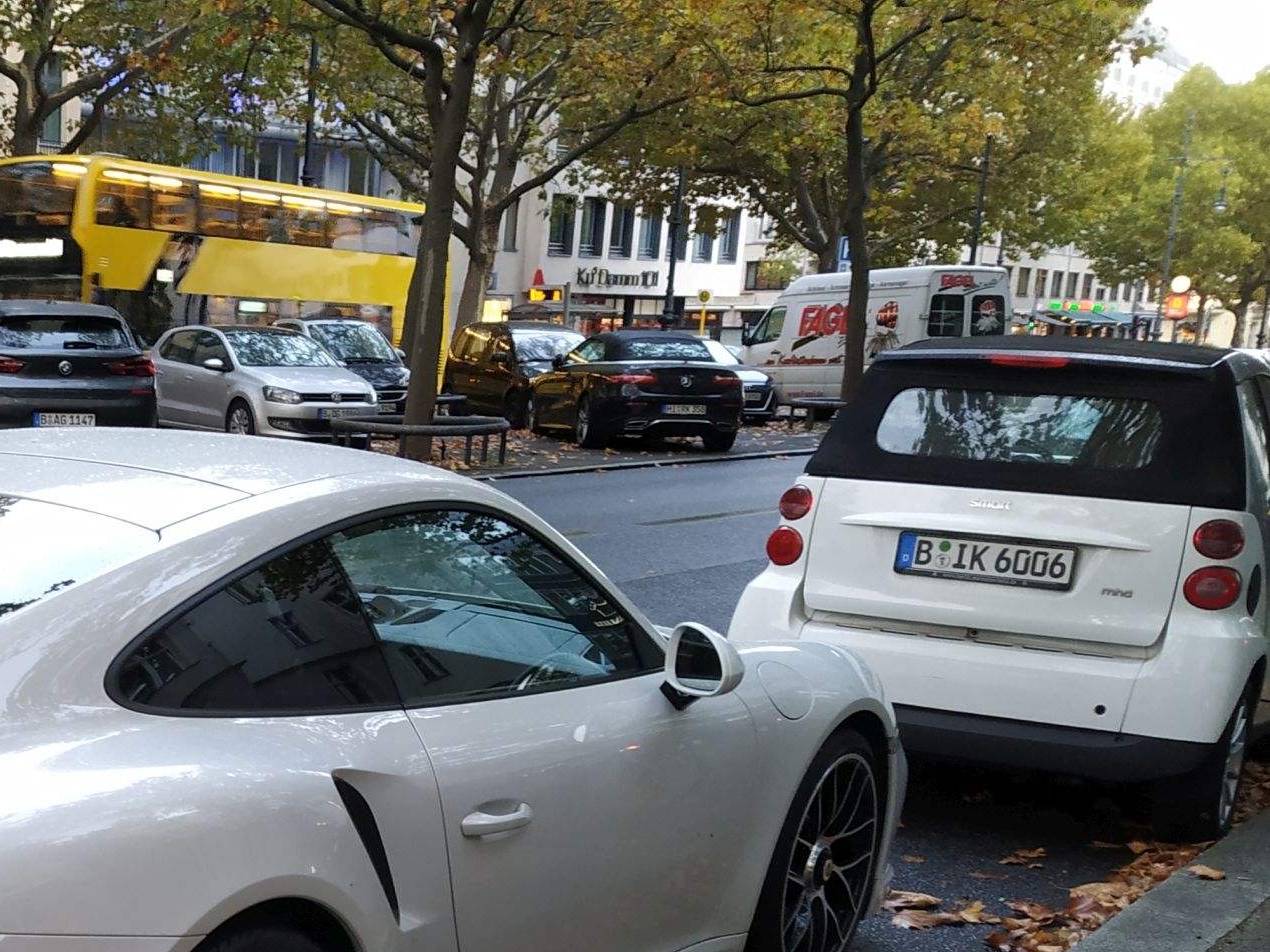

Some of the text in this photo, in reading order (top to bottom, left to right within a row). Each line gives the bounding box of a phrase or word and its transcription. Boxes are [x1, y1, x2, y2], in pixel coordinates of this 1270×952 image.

[54, 414, 67, 425] AG
[69, 415, 94, 426] 1147
[969, 499, 1012, 511] smart
[914, 540, 934, 566] B
[952, 543, 991, 572] IK
[994, 547, 1067, 579] 6006
